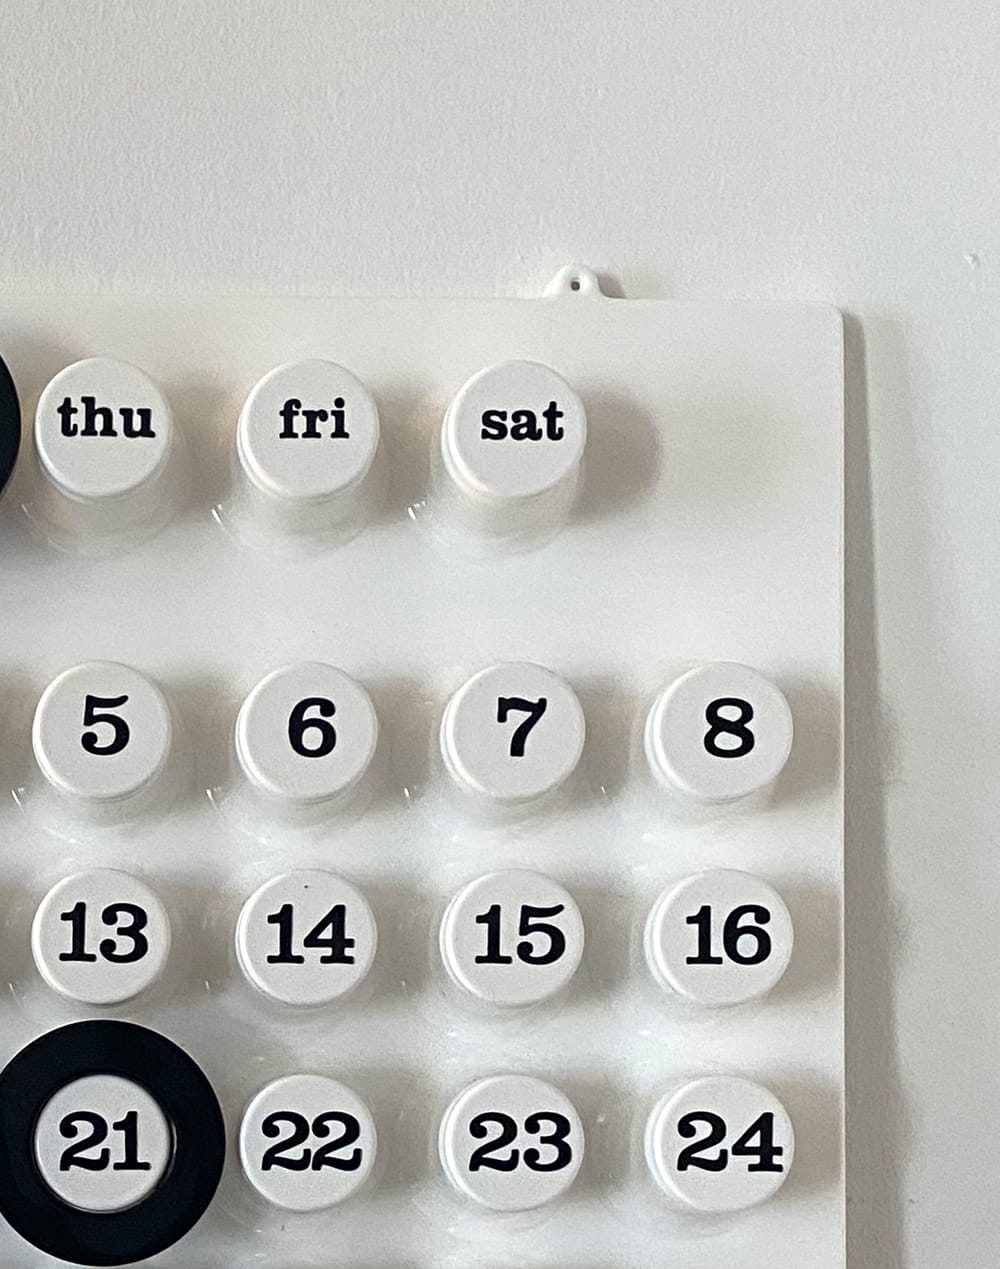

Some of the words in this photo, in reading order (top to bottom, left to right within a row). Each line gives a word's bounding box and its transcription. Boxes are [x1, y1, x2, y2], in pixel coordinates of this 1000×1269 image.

[56, 396, 156, 439] thu
[279, 397, 350, 439] fri
[481, 400, 564, 442] sat
[80, 694, 130, 756] 5
[288, 697, 337, 758] 6
[497, 696, 548, 758] 7
[703, 697, 755, 759] 8
[58, 901, 149, 964] 13
[266, 903, 355, 965] 14
[474, 904, 566, 966] 15
[685, 904, 772, 966] 16
[59, 1110, 152, 1172] 21
[261, 1110, 363, 1172] 22
[468, 1111, 573, 1173] 23
[676, 1111, 784, 1173] 24
